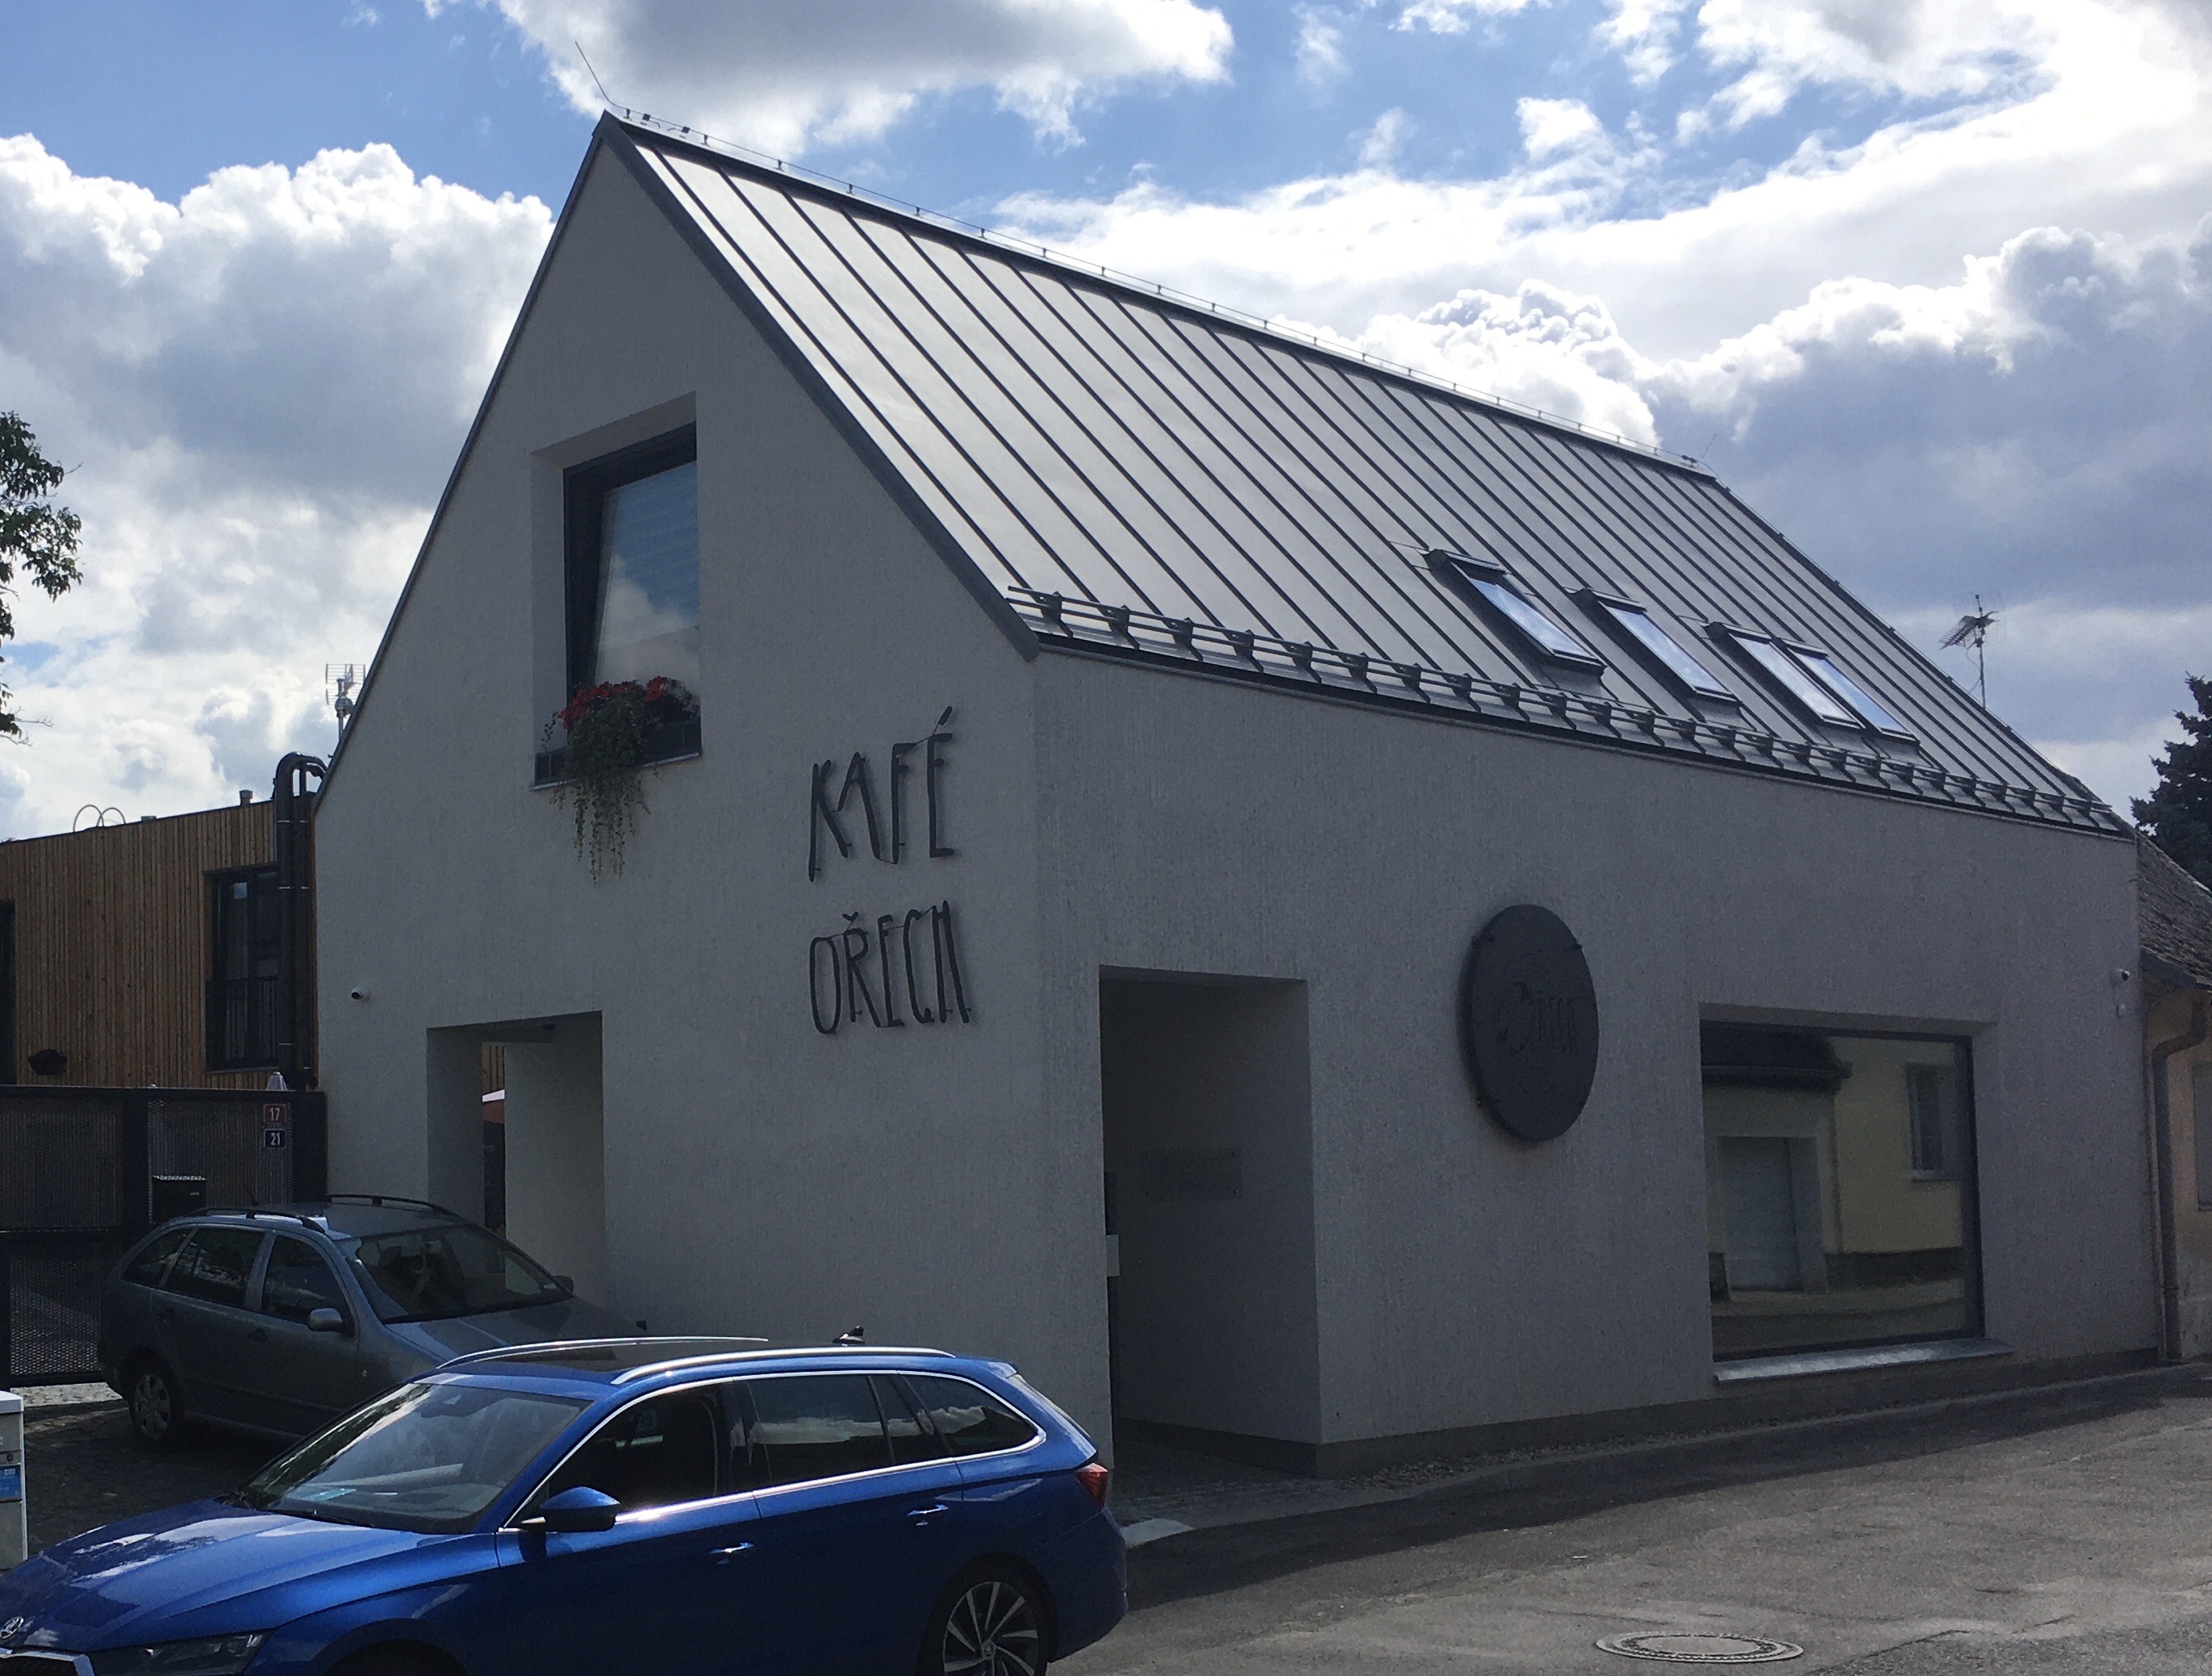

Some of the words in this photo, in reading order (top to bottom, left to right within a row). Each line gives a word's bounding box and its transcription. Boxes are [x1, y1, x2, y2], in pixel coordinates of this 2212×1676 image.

[808, 706, 954, 882] KAFÉ
[810, 901, 971, 1034] OŘECH
[269, 1107, 281, 1122] 17
[270, 1132, 281, 1146] 21
